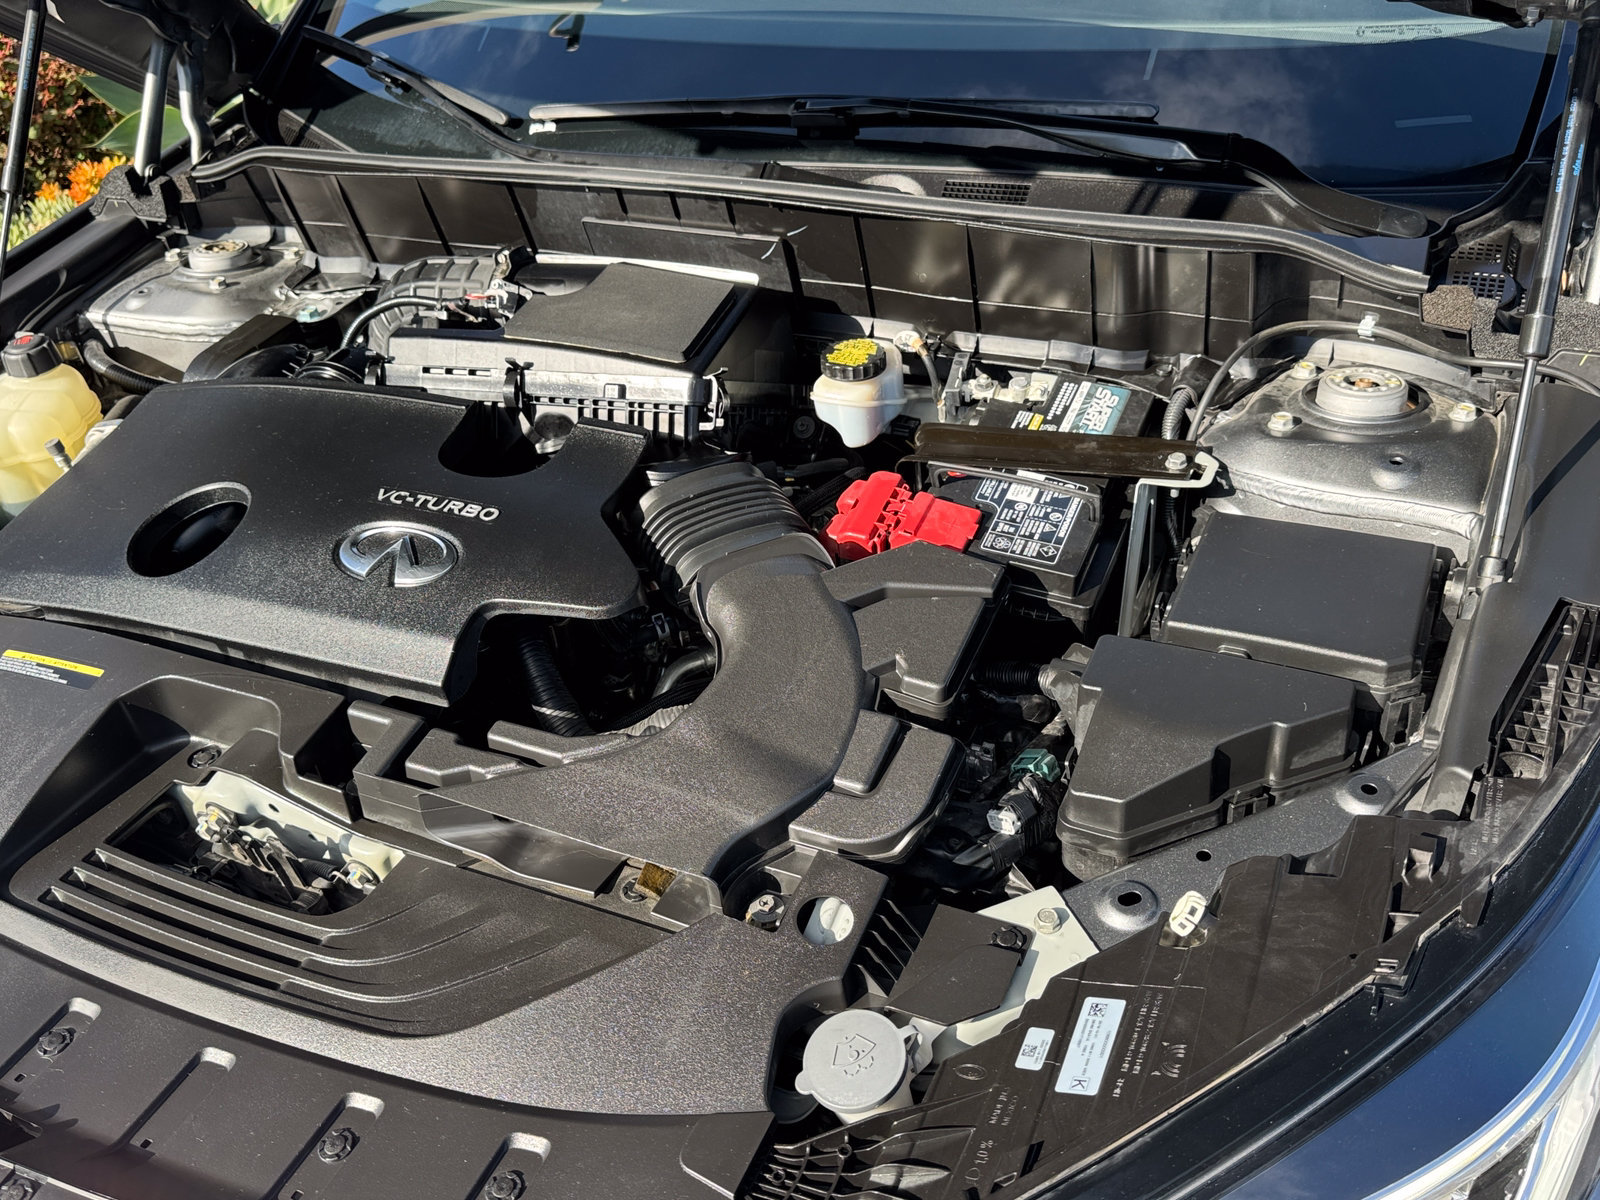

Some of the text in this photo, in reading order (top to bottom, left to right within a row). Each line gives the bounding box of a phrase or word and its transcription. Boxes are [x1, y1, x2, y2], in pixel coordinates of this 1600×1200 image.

[1079, 386, 1112, 429] START
[1091, 394, 1119, 431] SUPER
[377, 488, 501, 521] VC-TURBO
[1071, 1078, 1086, 1089] K
